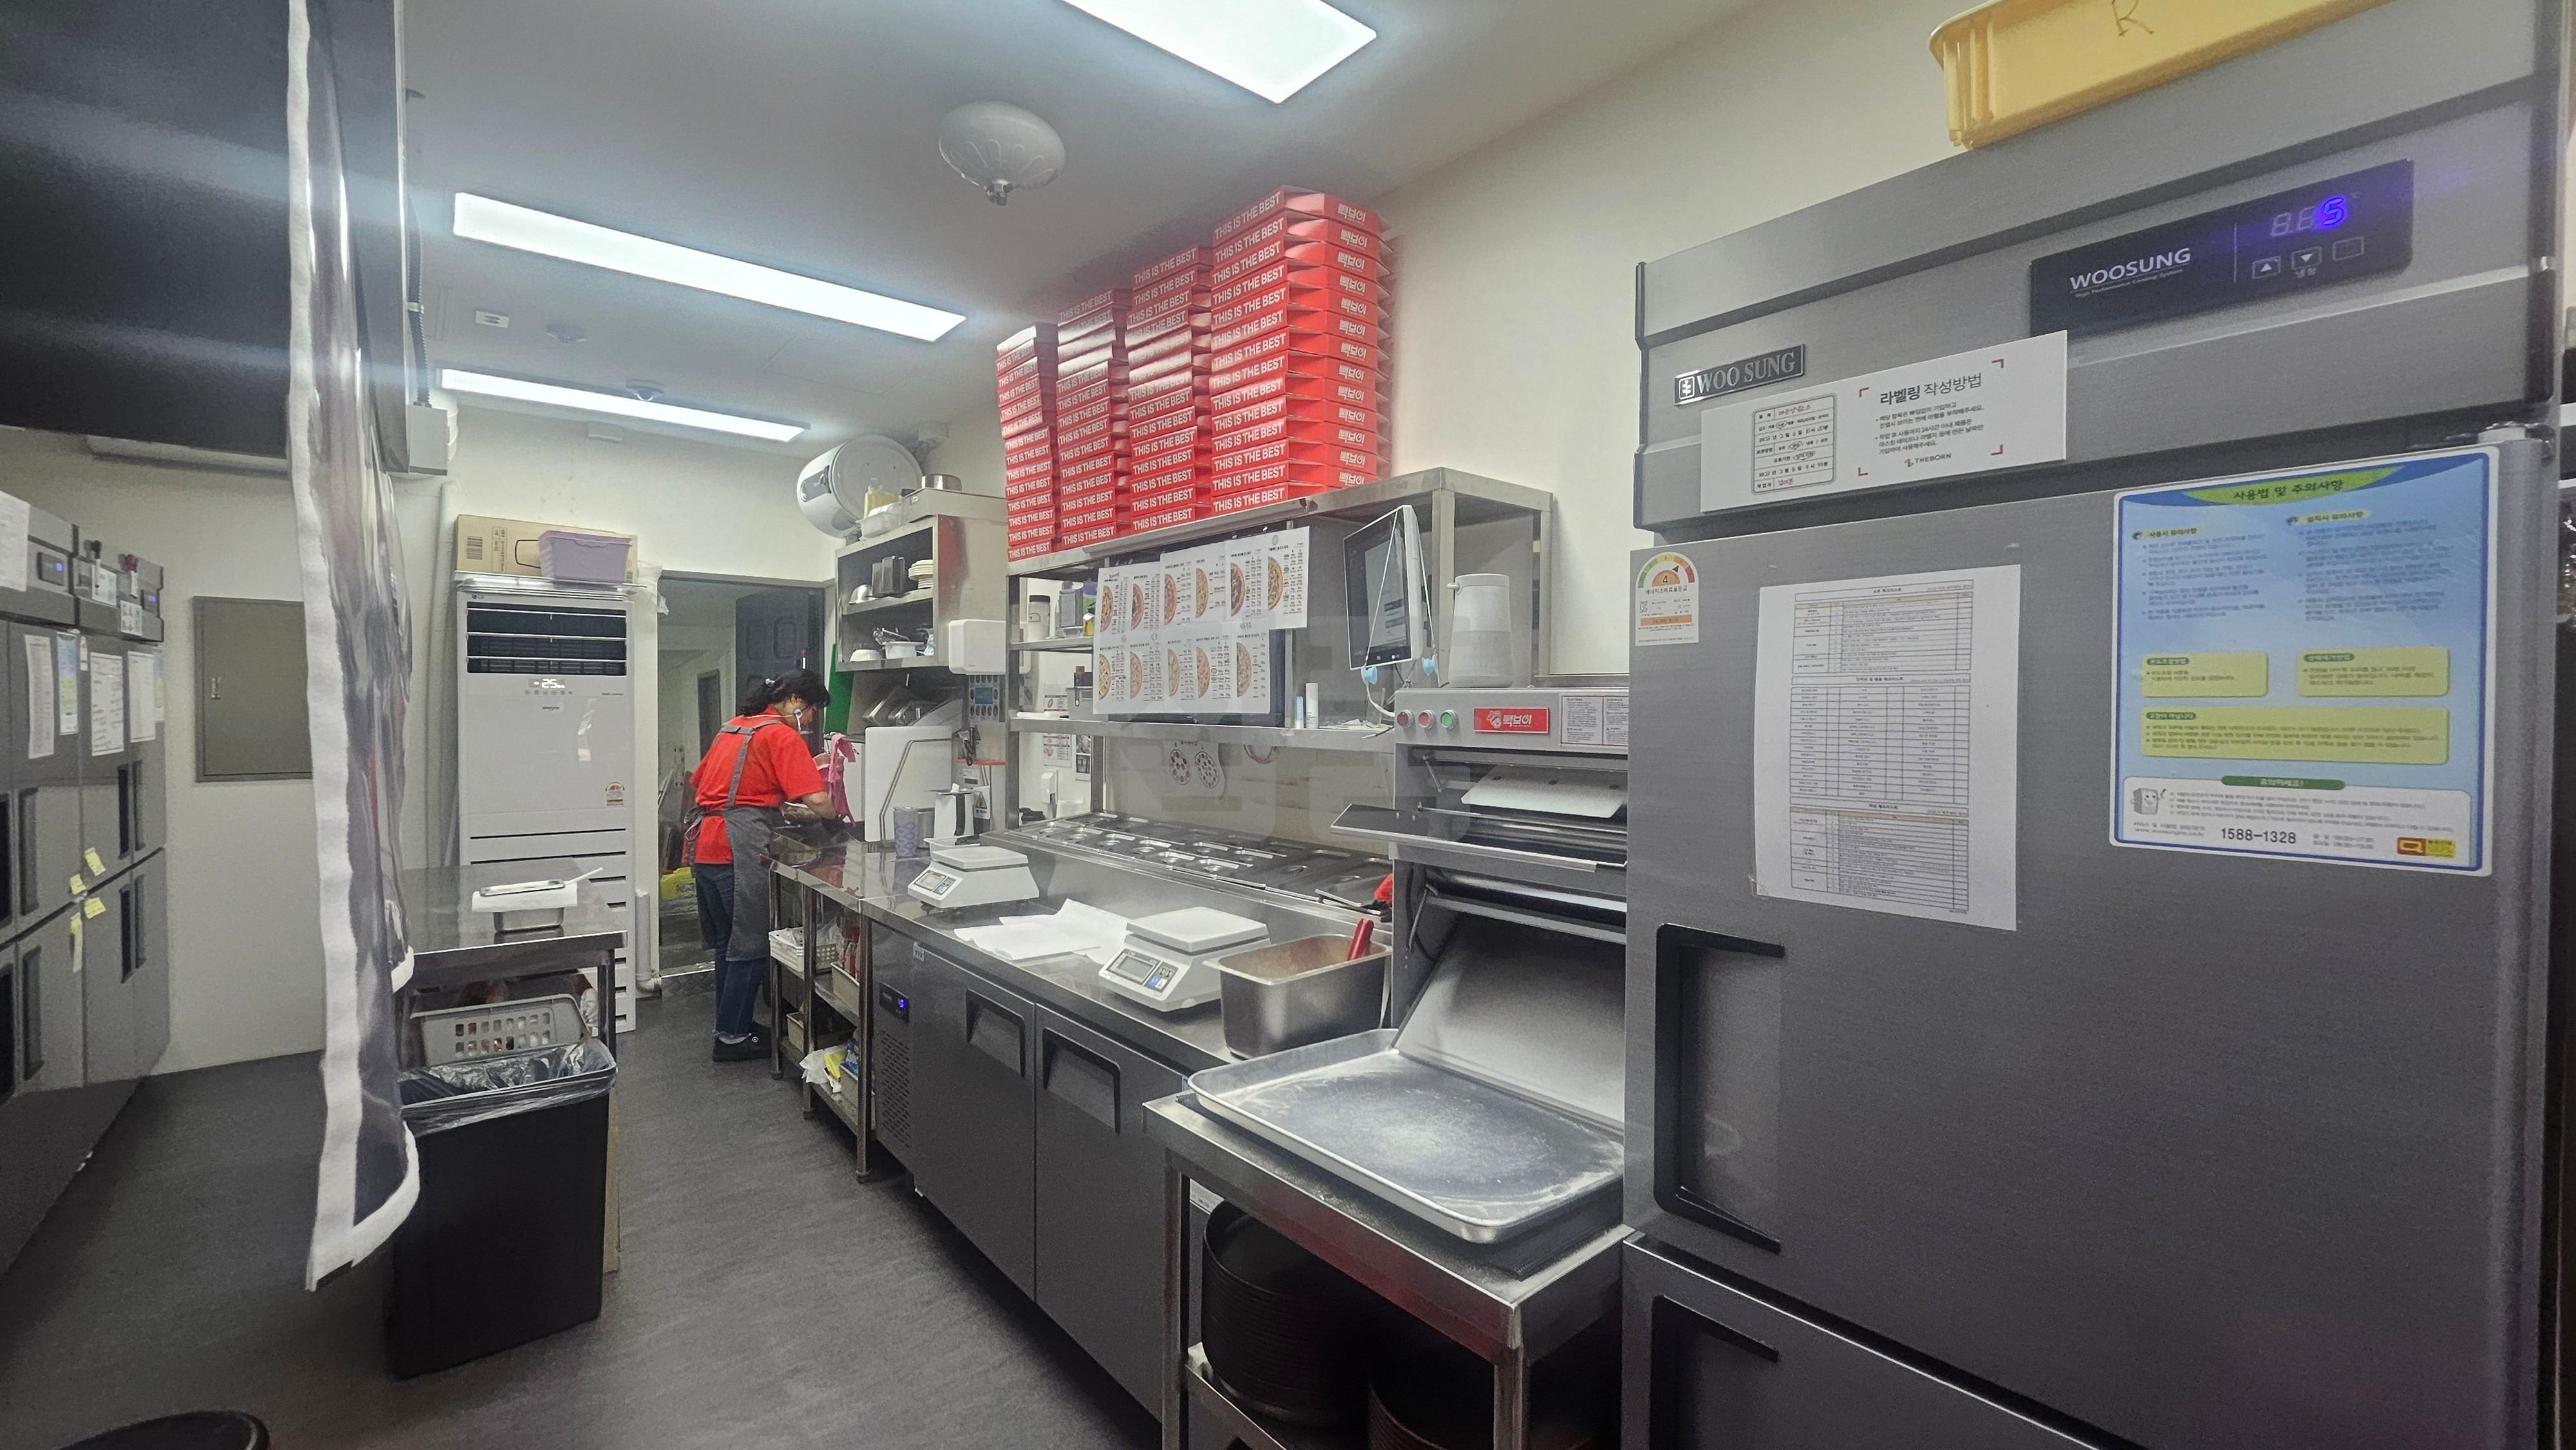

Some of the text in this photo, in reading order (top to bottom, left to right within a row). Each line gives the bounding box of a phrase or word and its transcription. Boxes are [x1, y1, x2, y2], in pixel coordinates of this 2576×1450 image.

[1215, 191, 1281, 240] THIS IS THE BEST
[1215, 218, 1284, 263] THIS IS THE BEST
[1212, 241, 1280, 284] THIS IS THE BEST
[2070, 248, 2191, 289] WOOSUNG
[1213, 265, 1284, 305] THIS IS THE BEST
[1213, 287, 1286, 325] THIS IS THE BEST
[1697, 352, 1796, 394] WOO SUNG
[1213, 378, 1283, 411] THIS IS THE BEST
[1880, 373, 1982, 405] 라벨링 작성방법
[1133, 431, 1195, 457] THIS IS THE BEST
[1214, 422, 1283, 452] THIS IS THE BEST
[1062, 455, 1112, 478] THIS IS THE BEST
[1915, 453, 1952, 464] THEBORN
[1132, 488, 1193, 511] THIS IS THE BEST
[1213, 487, 1285, 513] THIS IS THE BEST
[2233, 479, 2344, 500] 사용법 및 주의사항
[1009, 510, 1053, 527] THIS IS THE BEST
[1063, 508, 1113, 528] THIS IS THE BEST
[1133, 508, 1192, 531] THIS IS THE BEST
[1009, 525, 1053, 541] THIS IS THE BEST
[1063, 526, 1114, 545] THIS IS THE BEST
[1662, 575, 1668, 583] 4
[542, 679, 557, 688] 25
[2221, 828, 2297, 844] 1588-1328
